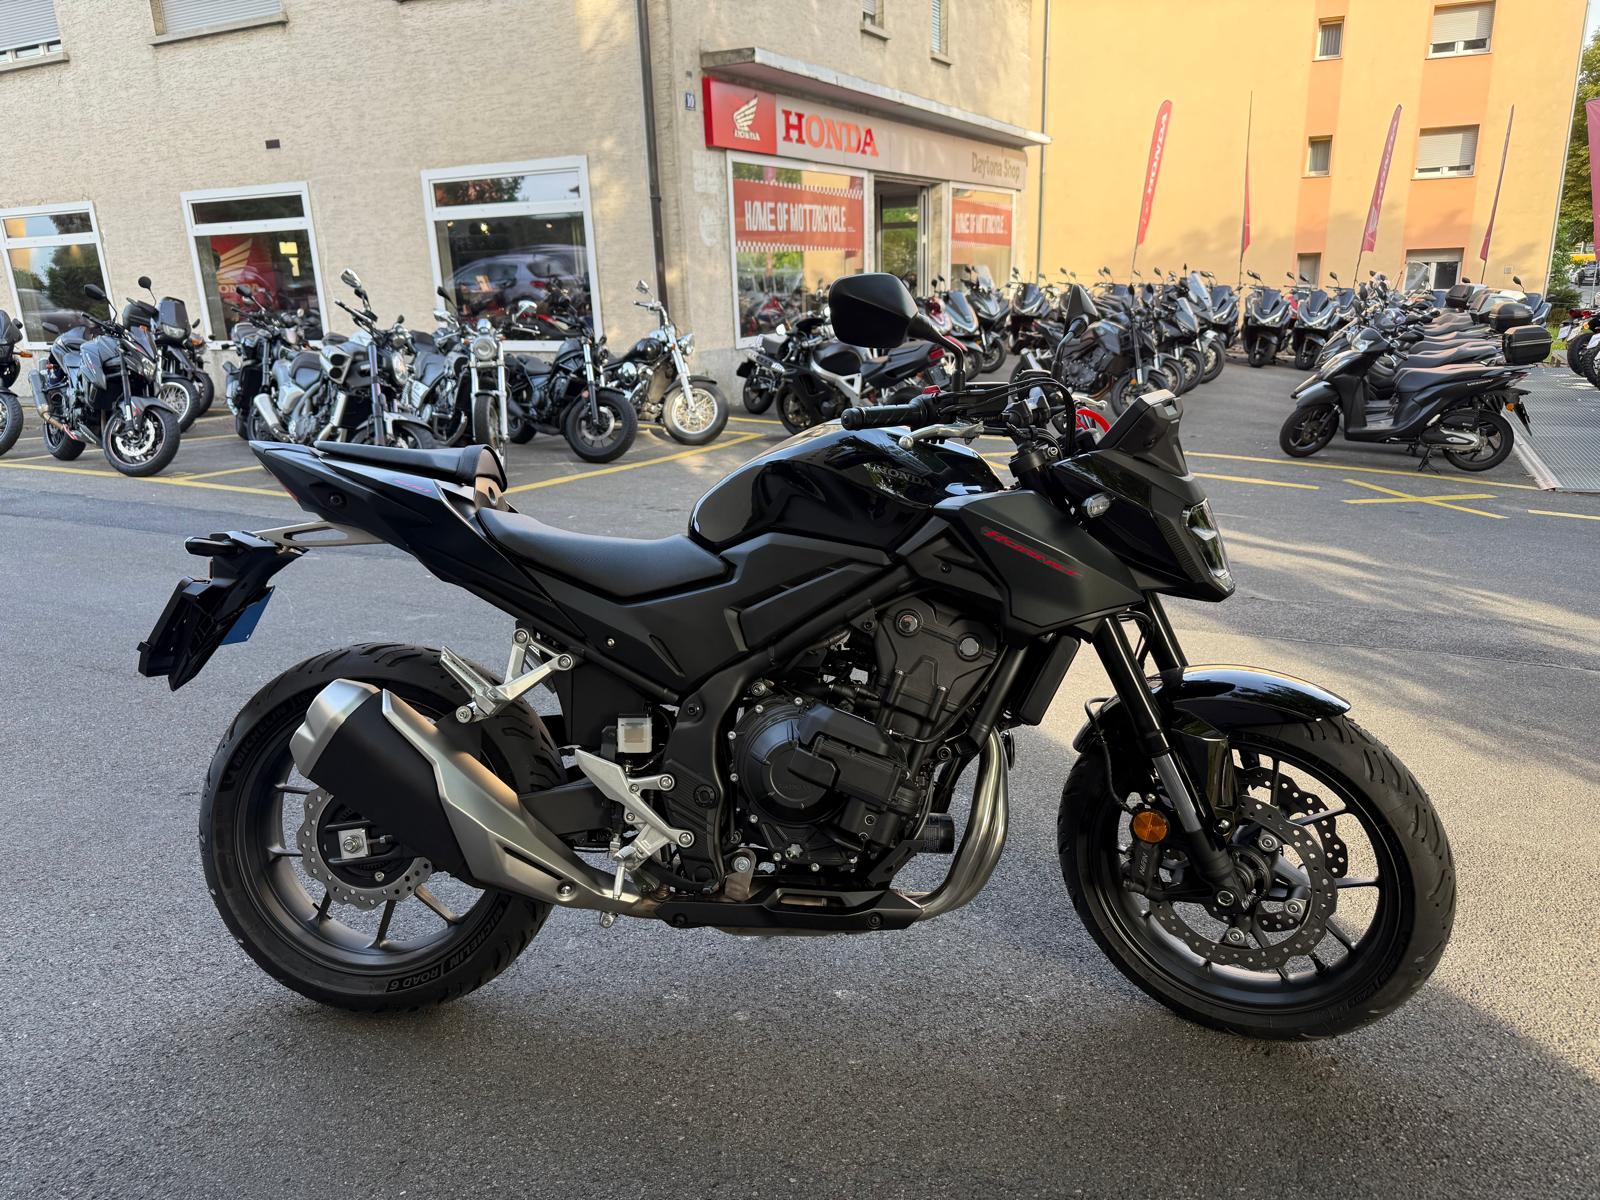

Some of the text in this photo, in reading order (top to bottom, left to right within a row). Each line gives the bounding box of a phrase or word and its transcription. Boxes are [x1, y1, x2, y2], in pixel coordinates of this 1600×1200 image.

[734, 129, 761, 142] HONDA
[781, 109, 879, 157] HONDA
[972, 151, 1020, 183] Daytona Shop
[1147, 112, 1168, 195] HONDA
[777, 202, 789, 233] OF
[879, 465, 934, 489] HONDA
[402, 966, 440, 988] ROAD
